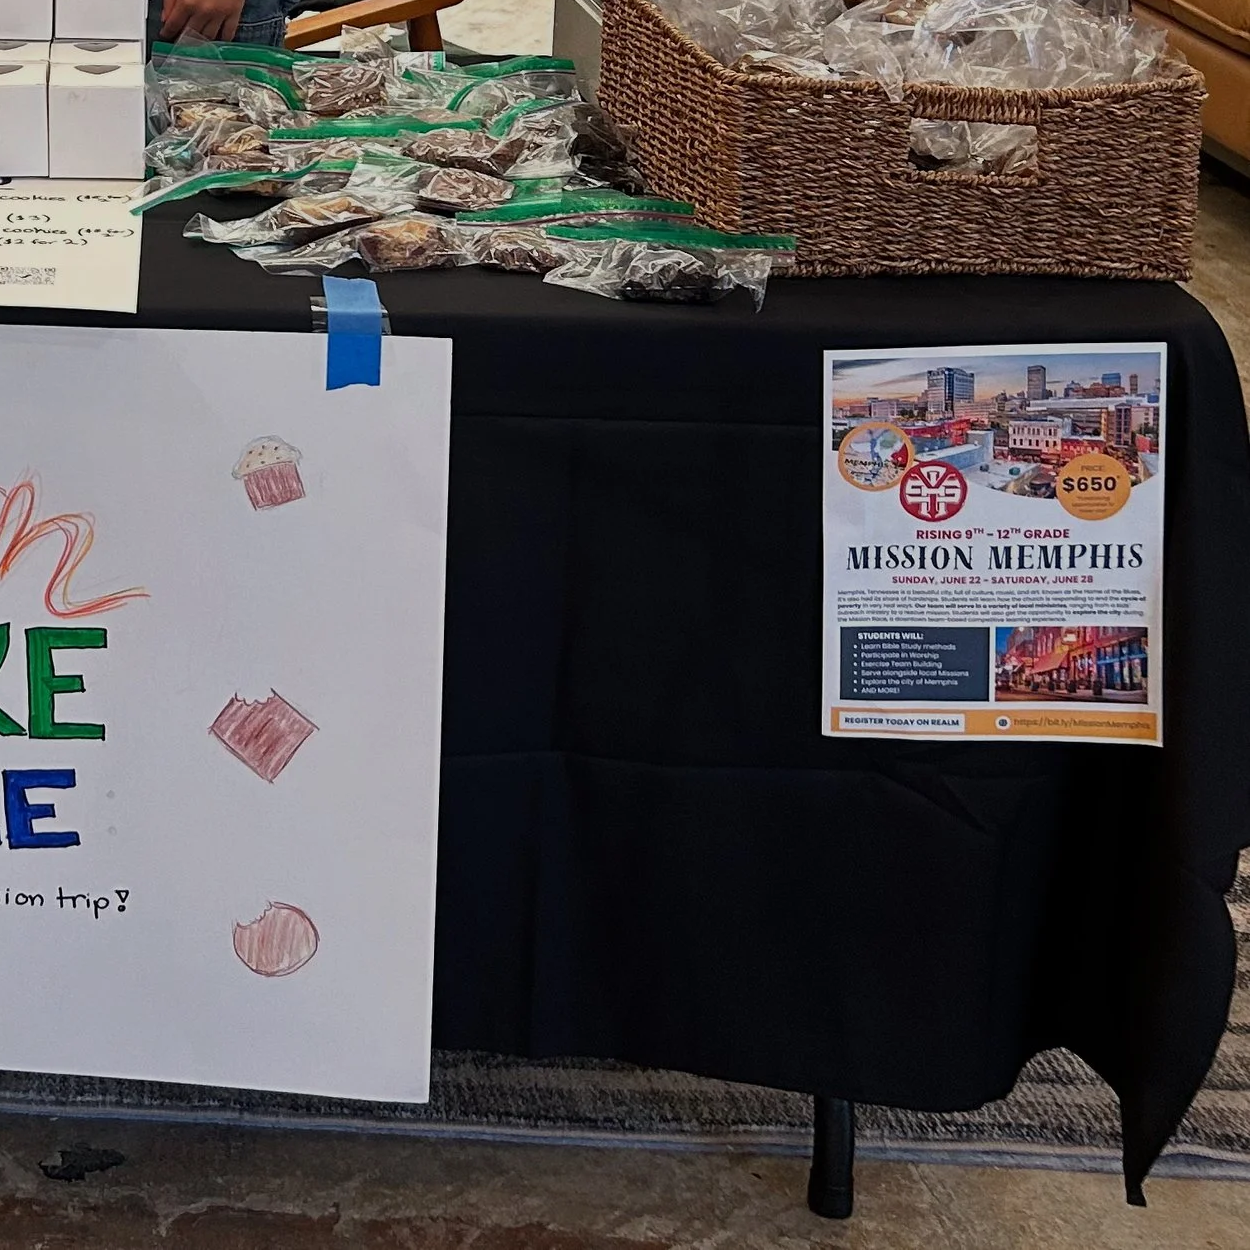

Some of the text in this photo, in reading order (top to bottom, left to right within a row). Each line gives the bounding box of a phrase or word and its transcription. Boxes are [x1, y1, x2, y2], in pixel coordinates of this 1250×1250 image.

[2, 227, 68, 235] cookies
[63, 238, 88, 246] 2)
[916, 529, 962, 540] RISING
[1024, 528, 1070, 539] GRADE
[846, 543, 1143, 570] MISSION MEMPHIS
[892, 576, 938, 585] SUNDAY,
[940, 576, 967, 584] JUNE
[991, 576, 1050, 585] SATURDAY,
[1052, 575, 1078, 584] JUNE
[1081, 575, 1094, 583] 28
[857, 632, 924, 640] STUDENTS WILL:
[901, 643, 921, 651] Study
[909, 652, 940, 660] Worship
[913, 661, 943, 669] Building
[882, 669, 918, 677] alongside
[861, 678, 886, 686] Explore
[901, 678, 914, 686] city
[844, 716, 960, 726] REGISTER TODAY ON REALM
